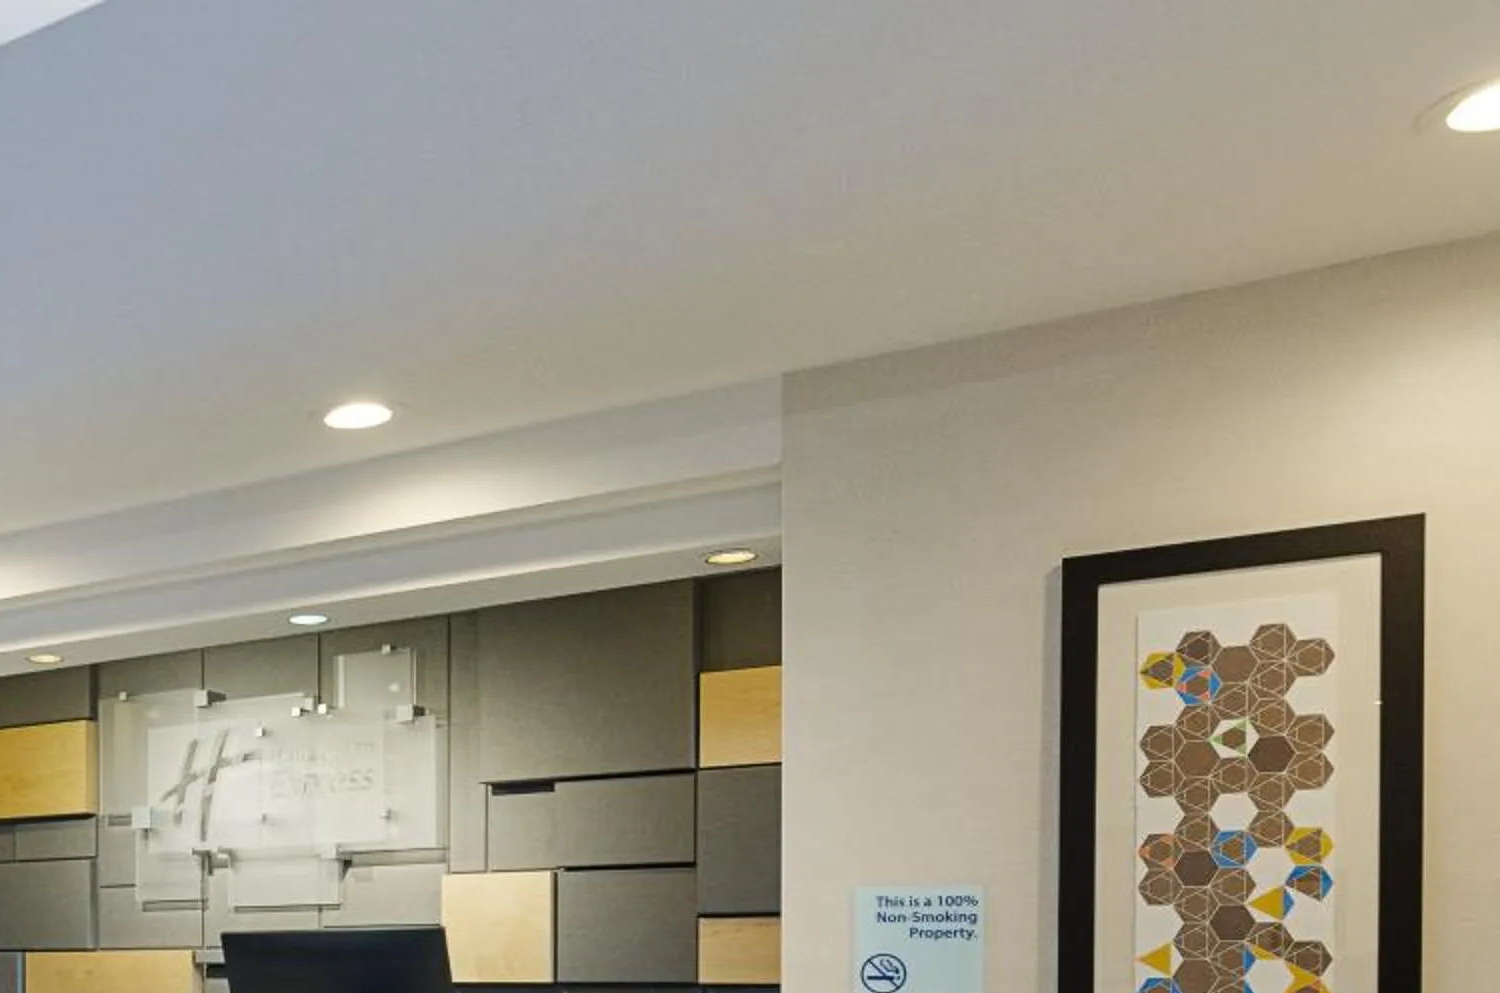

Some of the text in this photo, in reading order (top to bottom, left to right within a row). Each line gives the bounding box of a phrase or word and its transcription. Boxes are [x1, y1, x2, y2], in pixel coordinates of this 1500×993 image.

[876, 895, 979, 908] This is a 100%
